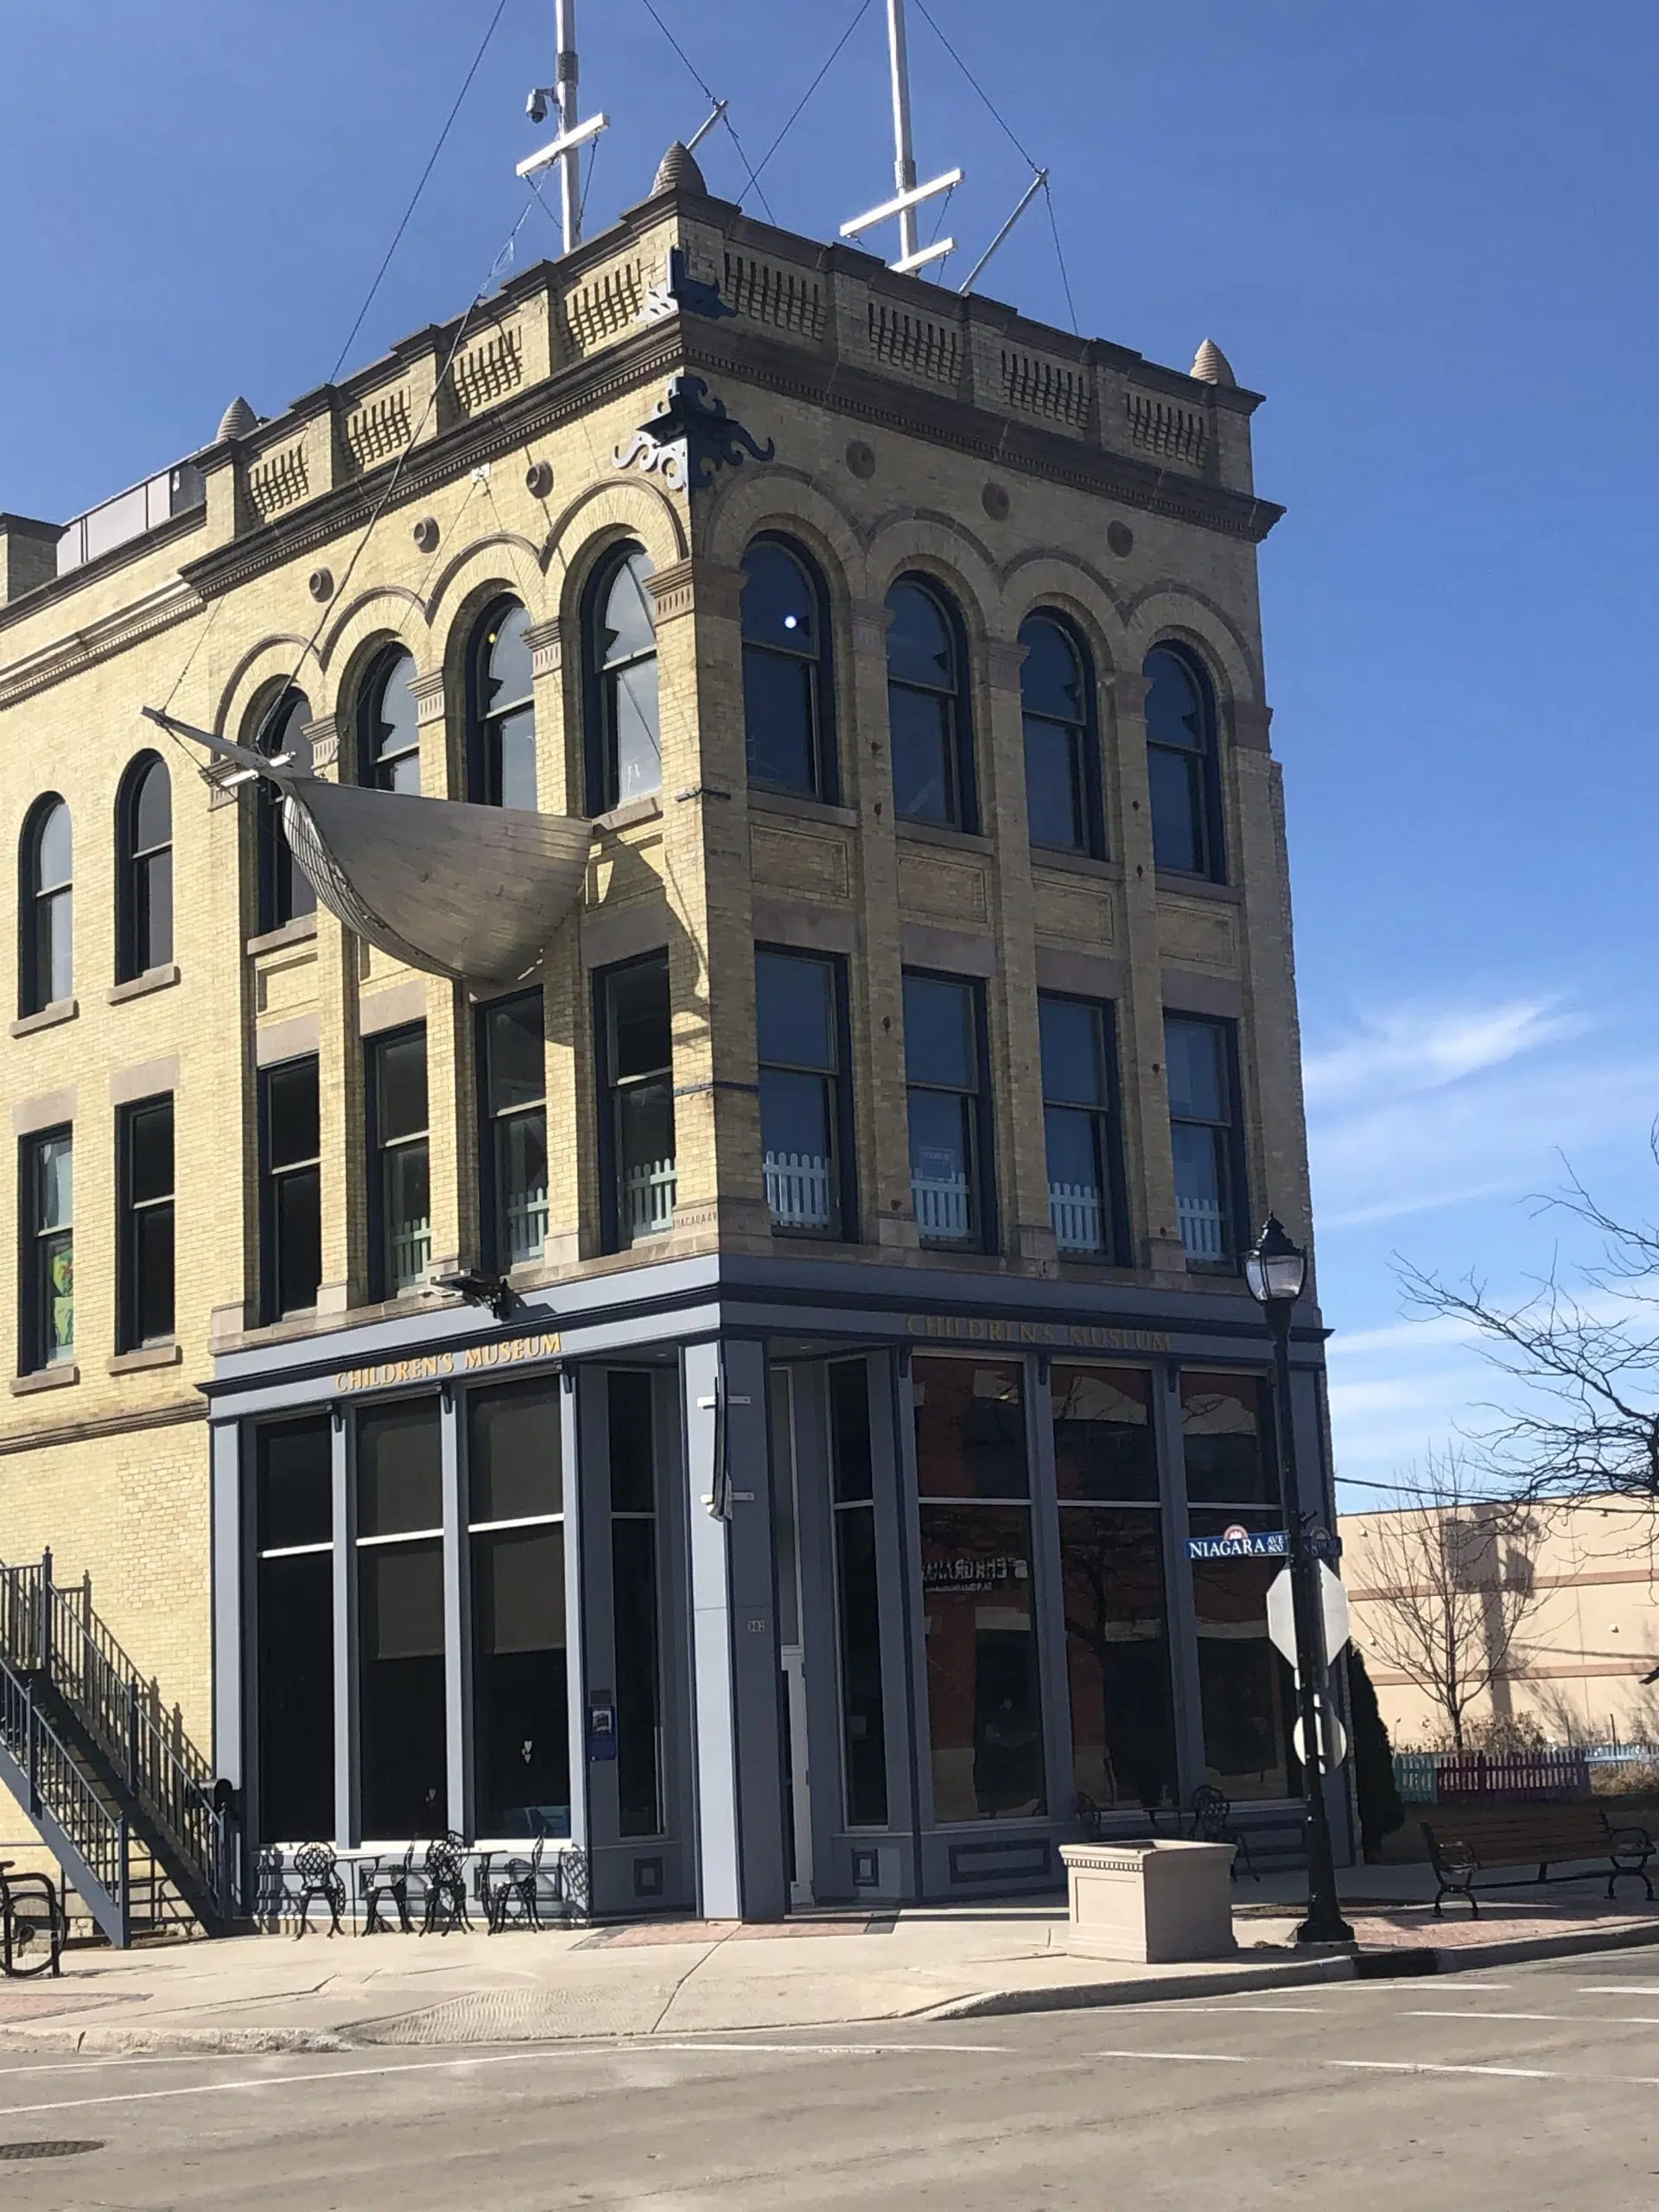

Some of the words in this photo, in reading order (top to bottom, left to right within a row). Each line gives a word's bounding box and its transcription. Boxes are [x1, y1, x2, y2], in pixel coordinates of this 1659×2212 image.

[907, 1314, 1054, 1344] CHILDREN'S
[1069, 1325, 1172, 1351] MUSEUM
[335, 1352, 454, 1393] CHILDREN'S
[464, 1332, 562, 1370] MUSEUM
[1189, 1539, 1265, 1558] NIAGARA
[1266, 1535, 1285, 1545] AVE
